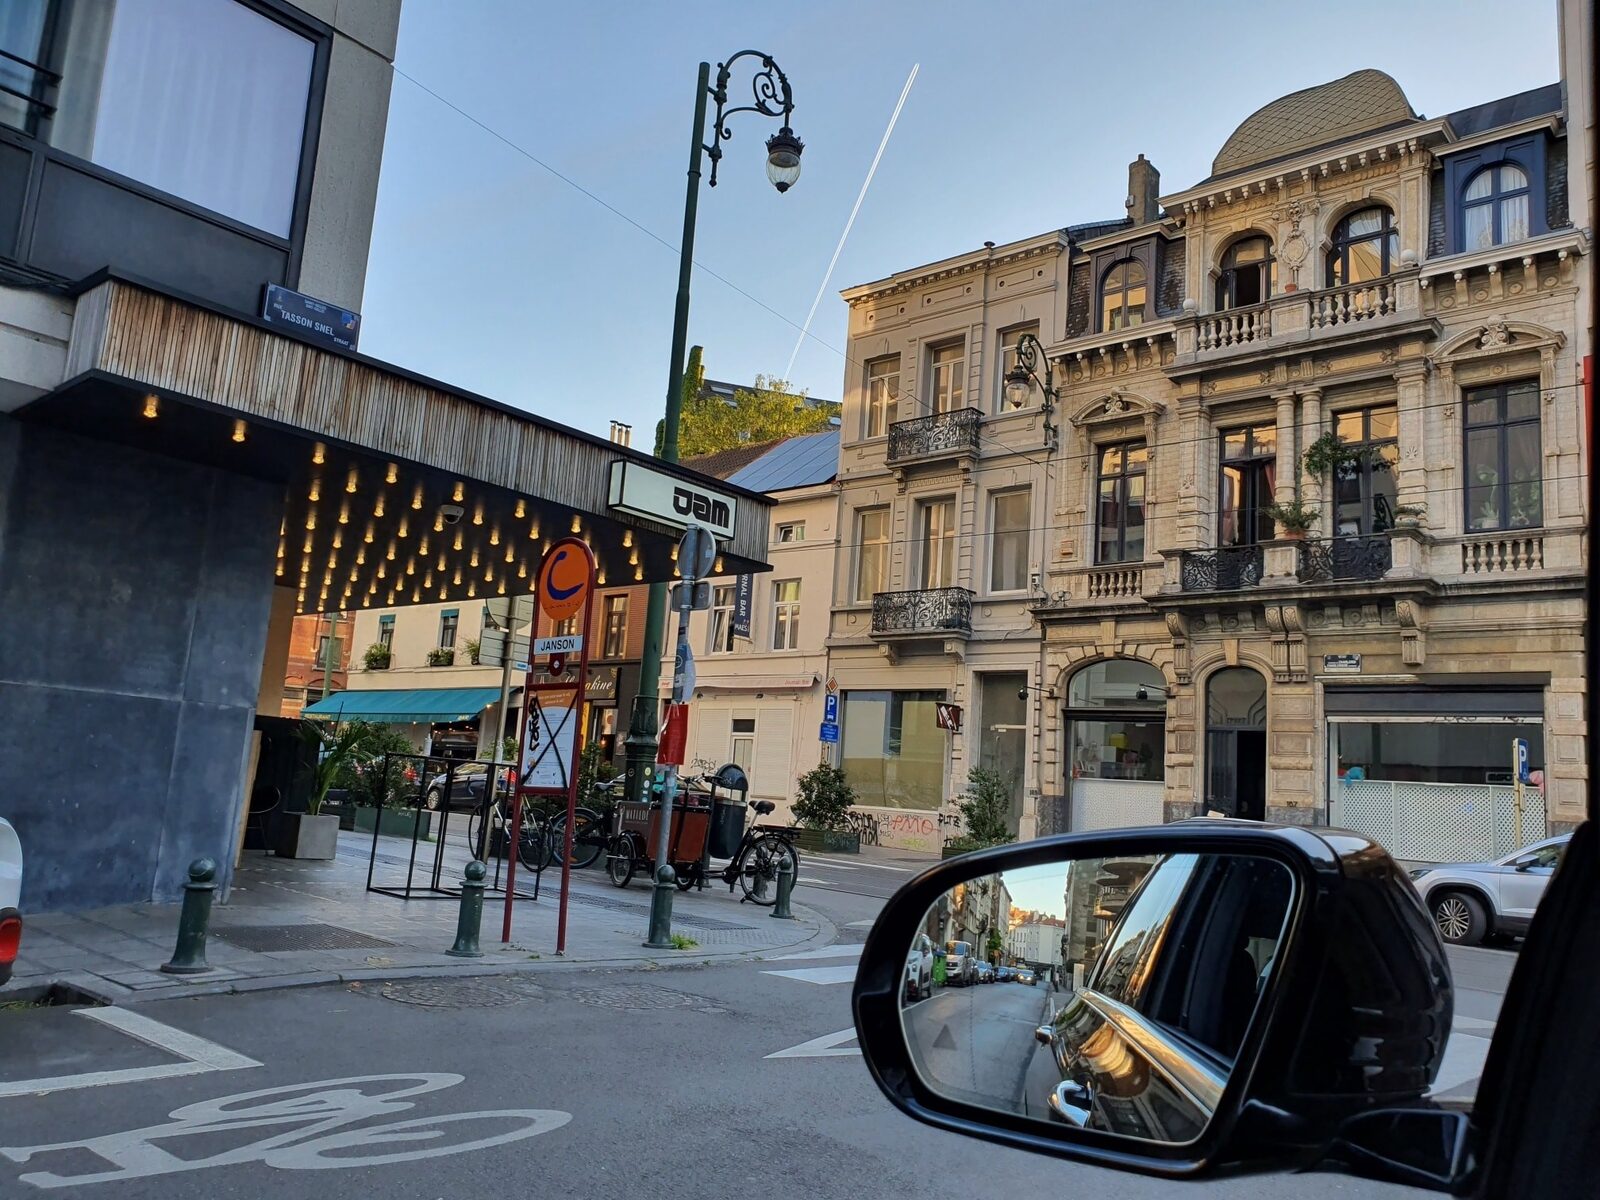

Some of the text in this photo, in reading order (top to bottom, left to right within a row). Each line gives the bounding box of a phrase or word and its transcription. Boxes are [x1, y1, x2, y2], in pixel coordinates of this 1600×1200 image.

[281, 310, 335, 336] TASSON SNEL
[739, 574, 749, 617] RNAL BAR
[540, 638, 576, 652] JANSON
[827, 696, 835, 711] P
[1518, 744, 1527, 774] P
